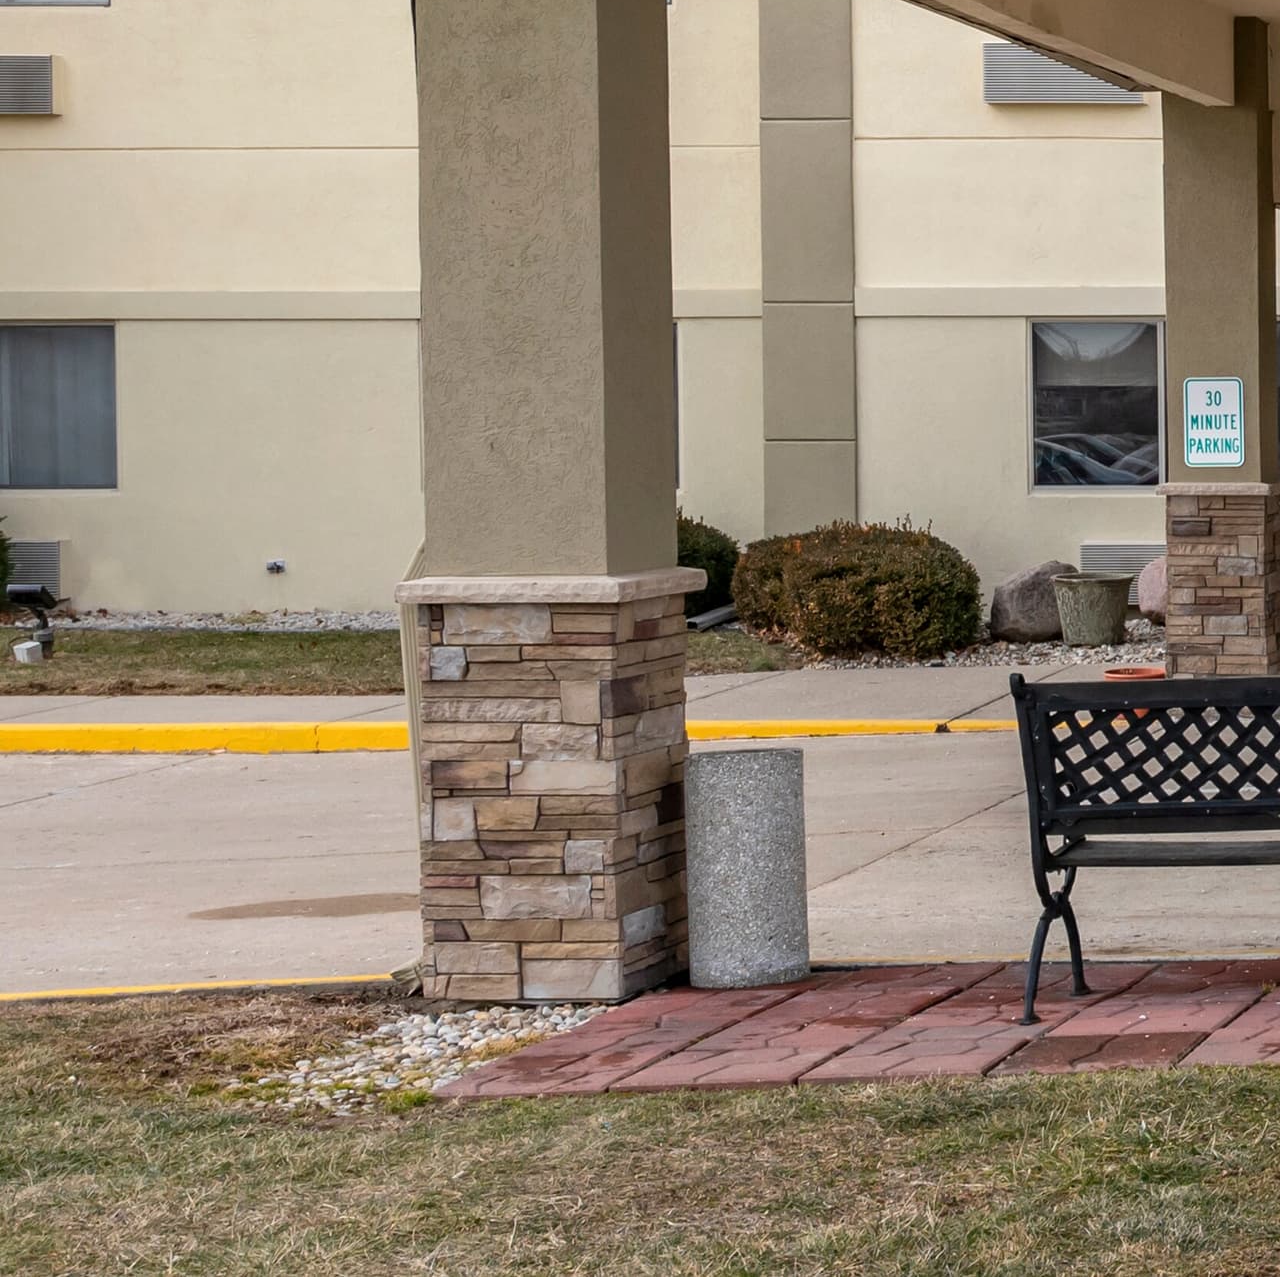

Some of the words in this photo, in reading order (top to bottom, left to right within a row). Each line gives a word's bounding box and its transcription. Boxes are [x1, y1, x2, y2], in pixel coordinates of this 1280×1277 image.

[1205, 390, 1222, 407] 30
[1190, 414, 1237, 430] MINUTE
[1189, 438, 1240, 454] PARKING
